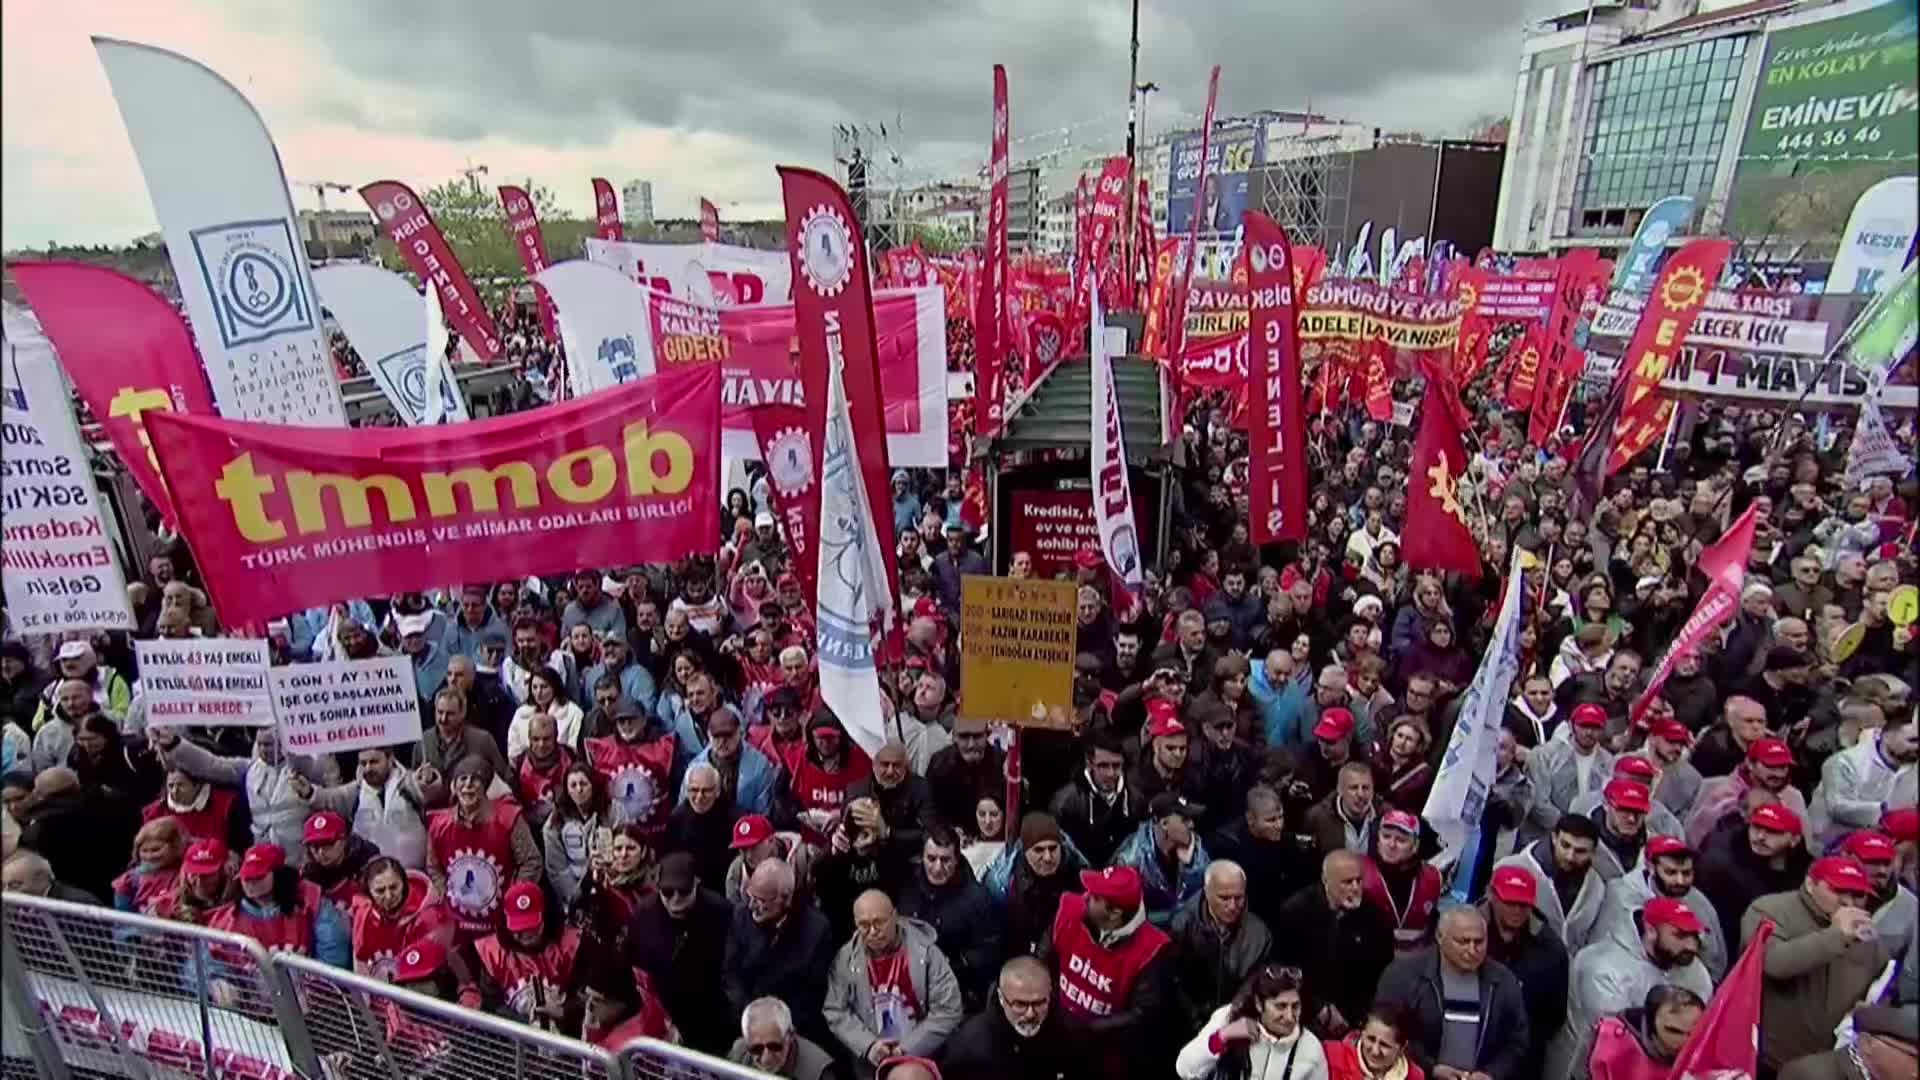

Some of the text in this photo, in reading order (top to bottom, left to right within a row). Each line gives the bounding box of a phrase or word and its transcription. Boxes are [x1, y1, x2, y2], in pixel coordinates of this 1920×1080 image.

[1777, 126, 1881, 151] 444 36 46
[1857, 231, 1908, 249] KESK
[1747, 318, 1789, 346] İÇİN
[215, 417, 694, 543] tmmob
[1024, 503, 1083, 520] Kredisiz,
[1035, 523, 1052, 533] ev
[1055, 523, 1072, 534] ve
[240, 546, 305, 569] TÜRK
[313, 529, 427, 558] MÜHENDİS
[434, 525, 462, 541] VE
[466, 518, 533, 539] MİMAR
[539, 510, 621, 533] ODALARI
[290, 674, 321, 688] GÜN
[341, 671, 358, 683] AY
[376, 667, 398, 679] YIL
[333, 684, 403, 701] BAŞLAYANA
[152, 702, 194, 714] ADALET
[199, 701, 244, 715] NEREDE
[298, 711, 317, 725] YIL
[320, 707, 357, 721] SONRA
[360, 700, 416, 717] EMEKLİLİK
[289, 731, 319, 746] ADİL
[1069, 953, 1113, 993] DİSK
